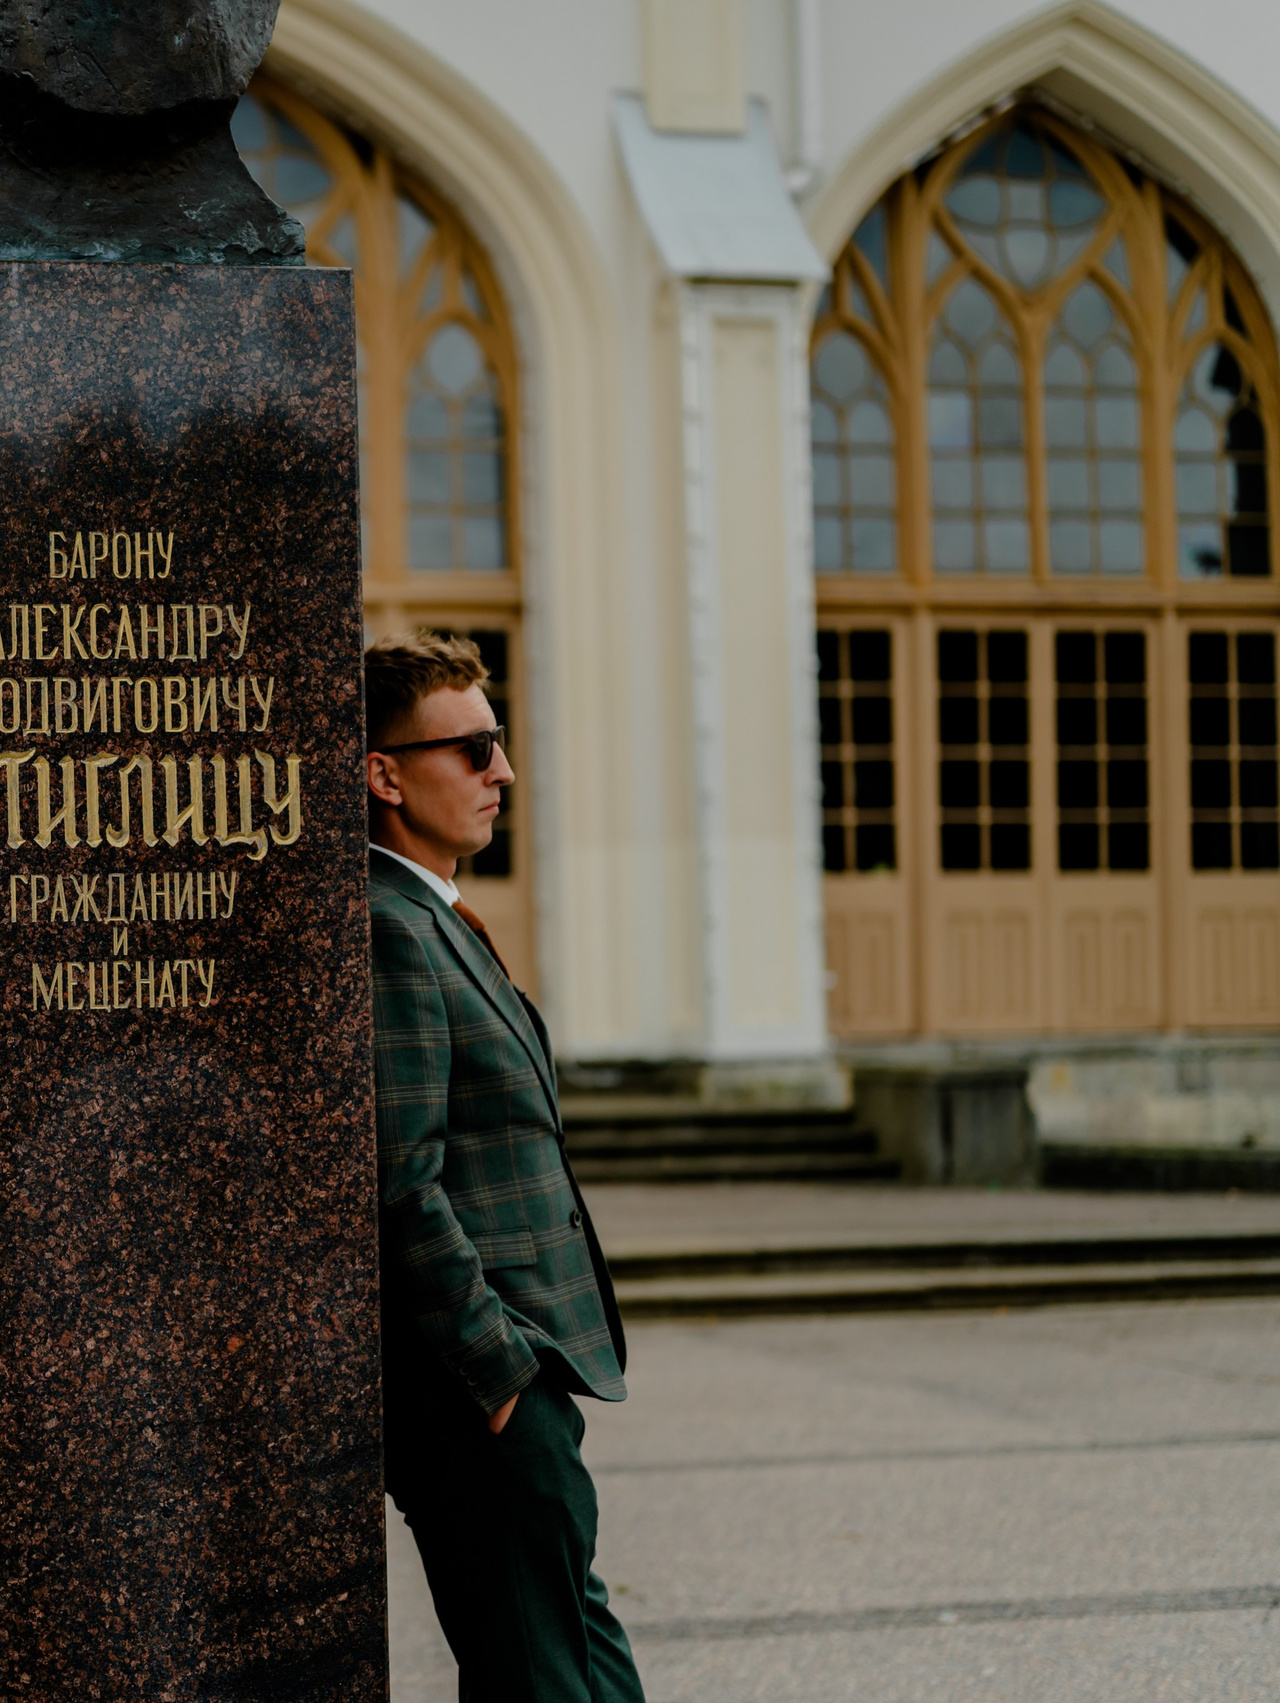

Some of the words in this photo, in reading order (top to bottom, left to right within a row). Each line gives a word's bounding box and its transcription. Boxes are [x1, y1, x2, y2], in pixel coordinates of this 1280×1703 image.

[49, 531, 175, 579] БАРОНУ
[9, 872, 238, 924] ГРАЖДАНИНУ
[32, 959, 216, 1013] МЕЦЕНАТУ
